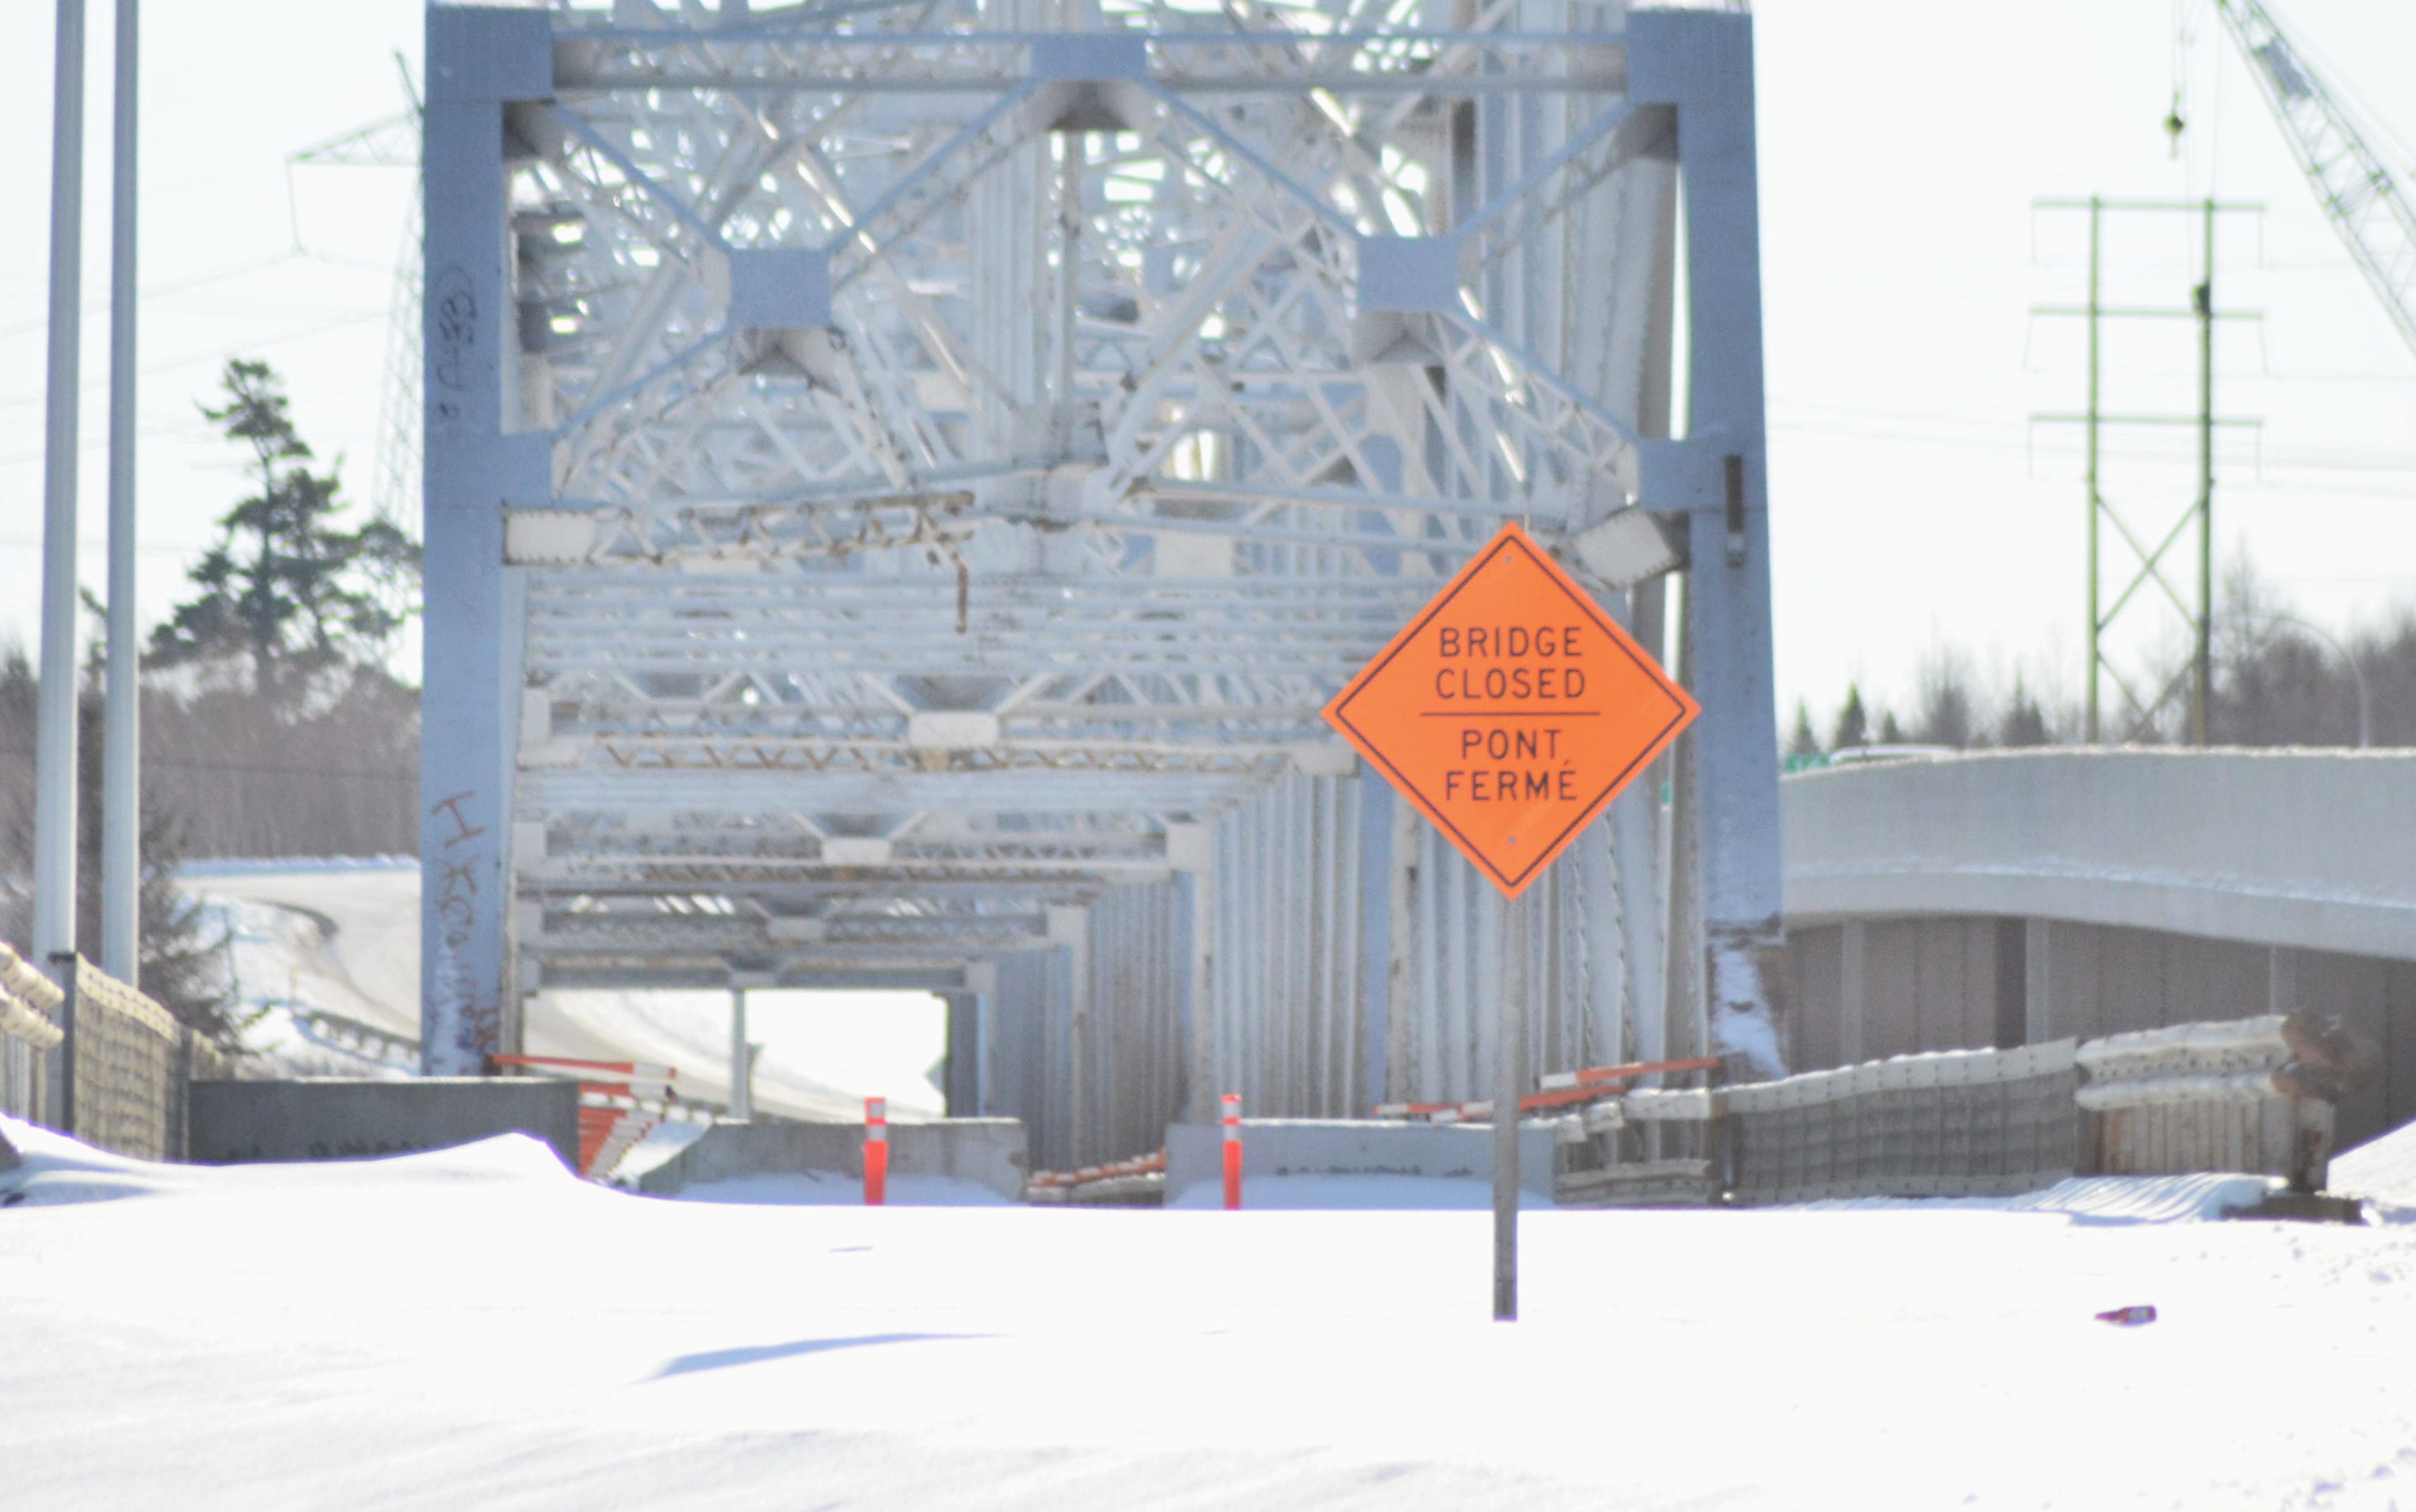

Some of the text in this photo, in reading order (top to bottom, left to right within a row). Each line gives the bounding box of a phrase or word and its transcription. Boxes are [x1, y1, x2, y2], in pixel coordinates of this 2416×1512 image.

[1440, 627, 1583, 657] BRIDGE
[1435, 668, 1586, 699] CLOSED
[1462, 729, 1562, 759] PONT
[1445, 759, 1578, 801] FERMÉ
